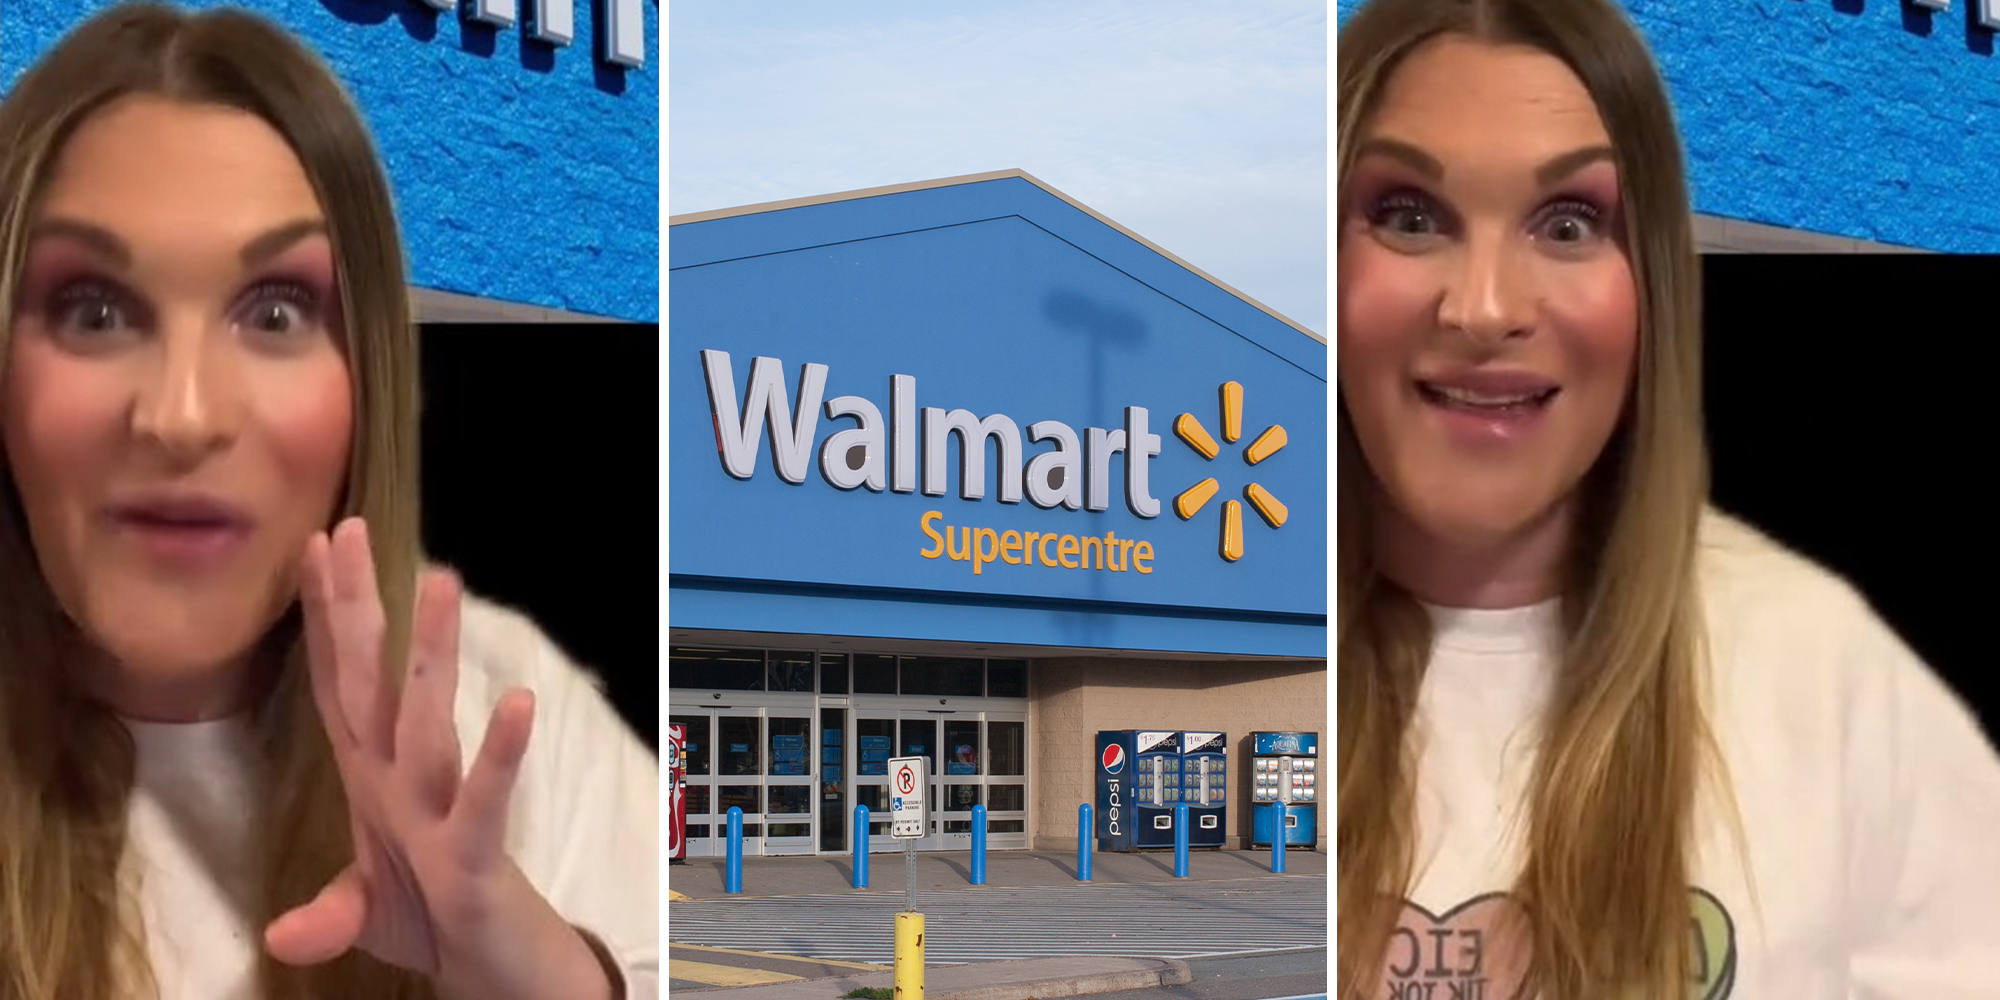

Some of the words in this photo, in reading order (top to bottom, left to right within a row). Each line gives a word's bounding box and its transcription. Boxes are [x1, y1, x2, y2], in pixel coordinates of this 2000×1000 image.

[700, 349, 1161, 519] Walmart
[920, 510, 1154, 575] Supercentre
[1108, 779, 1121, 836] pepsi
